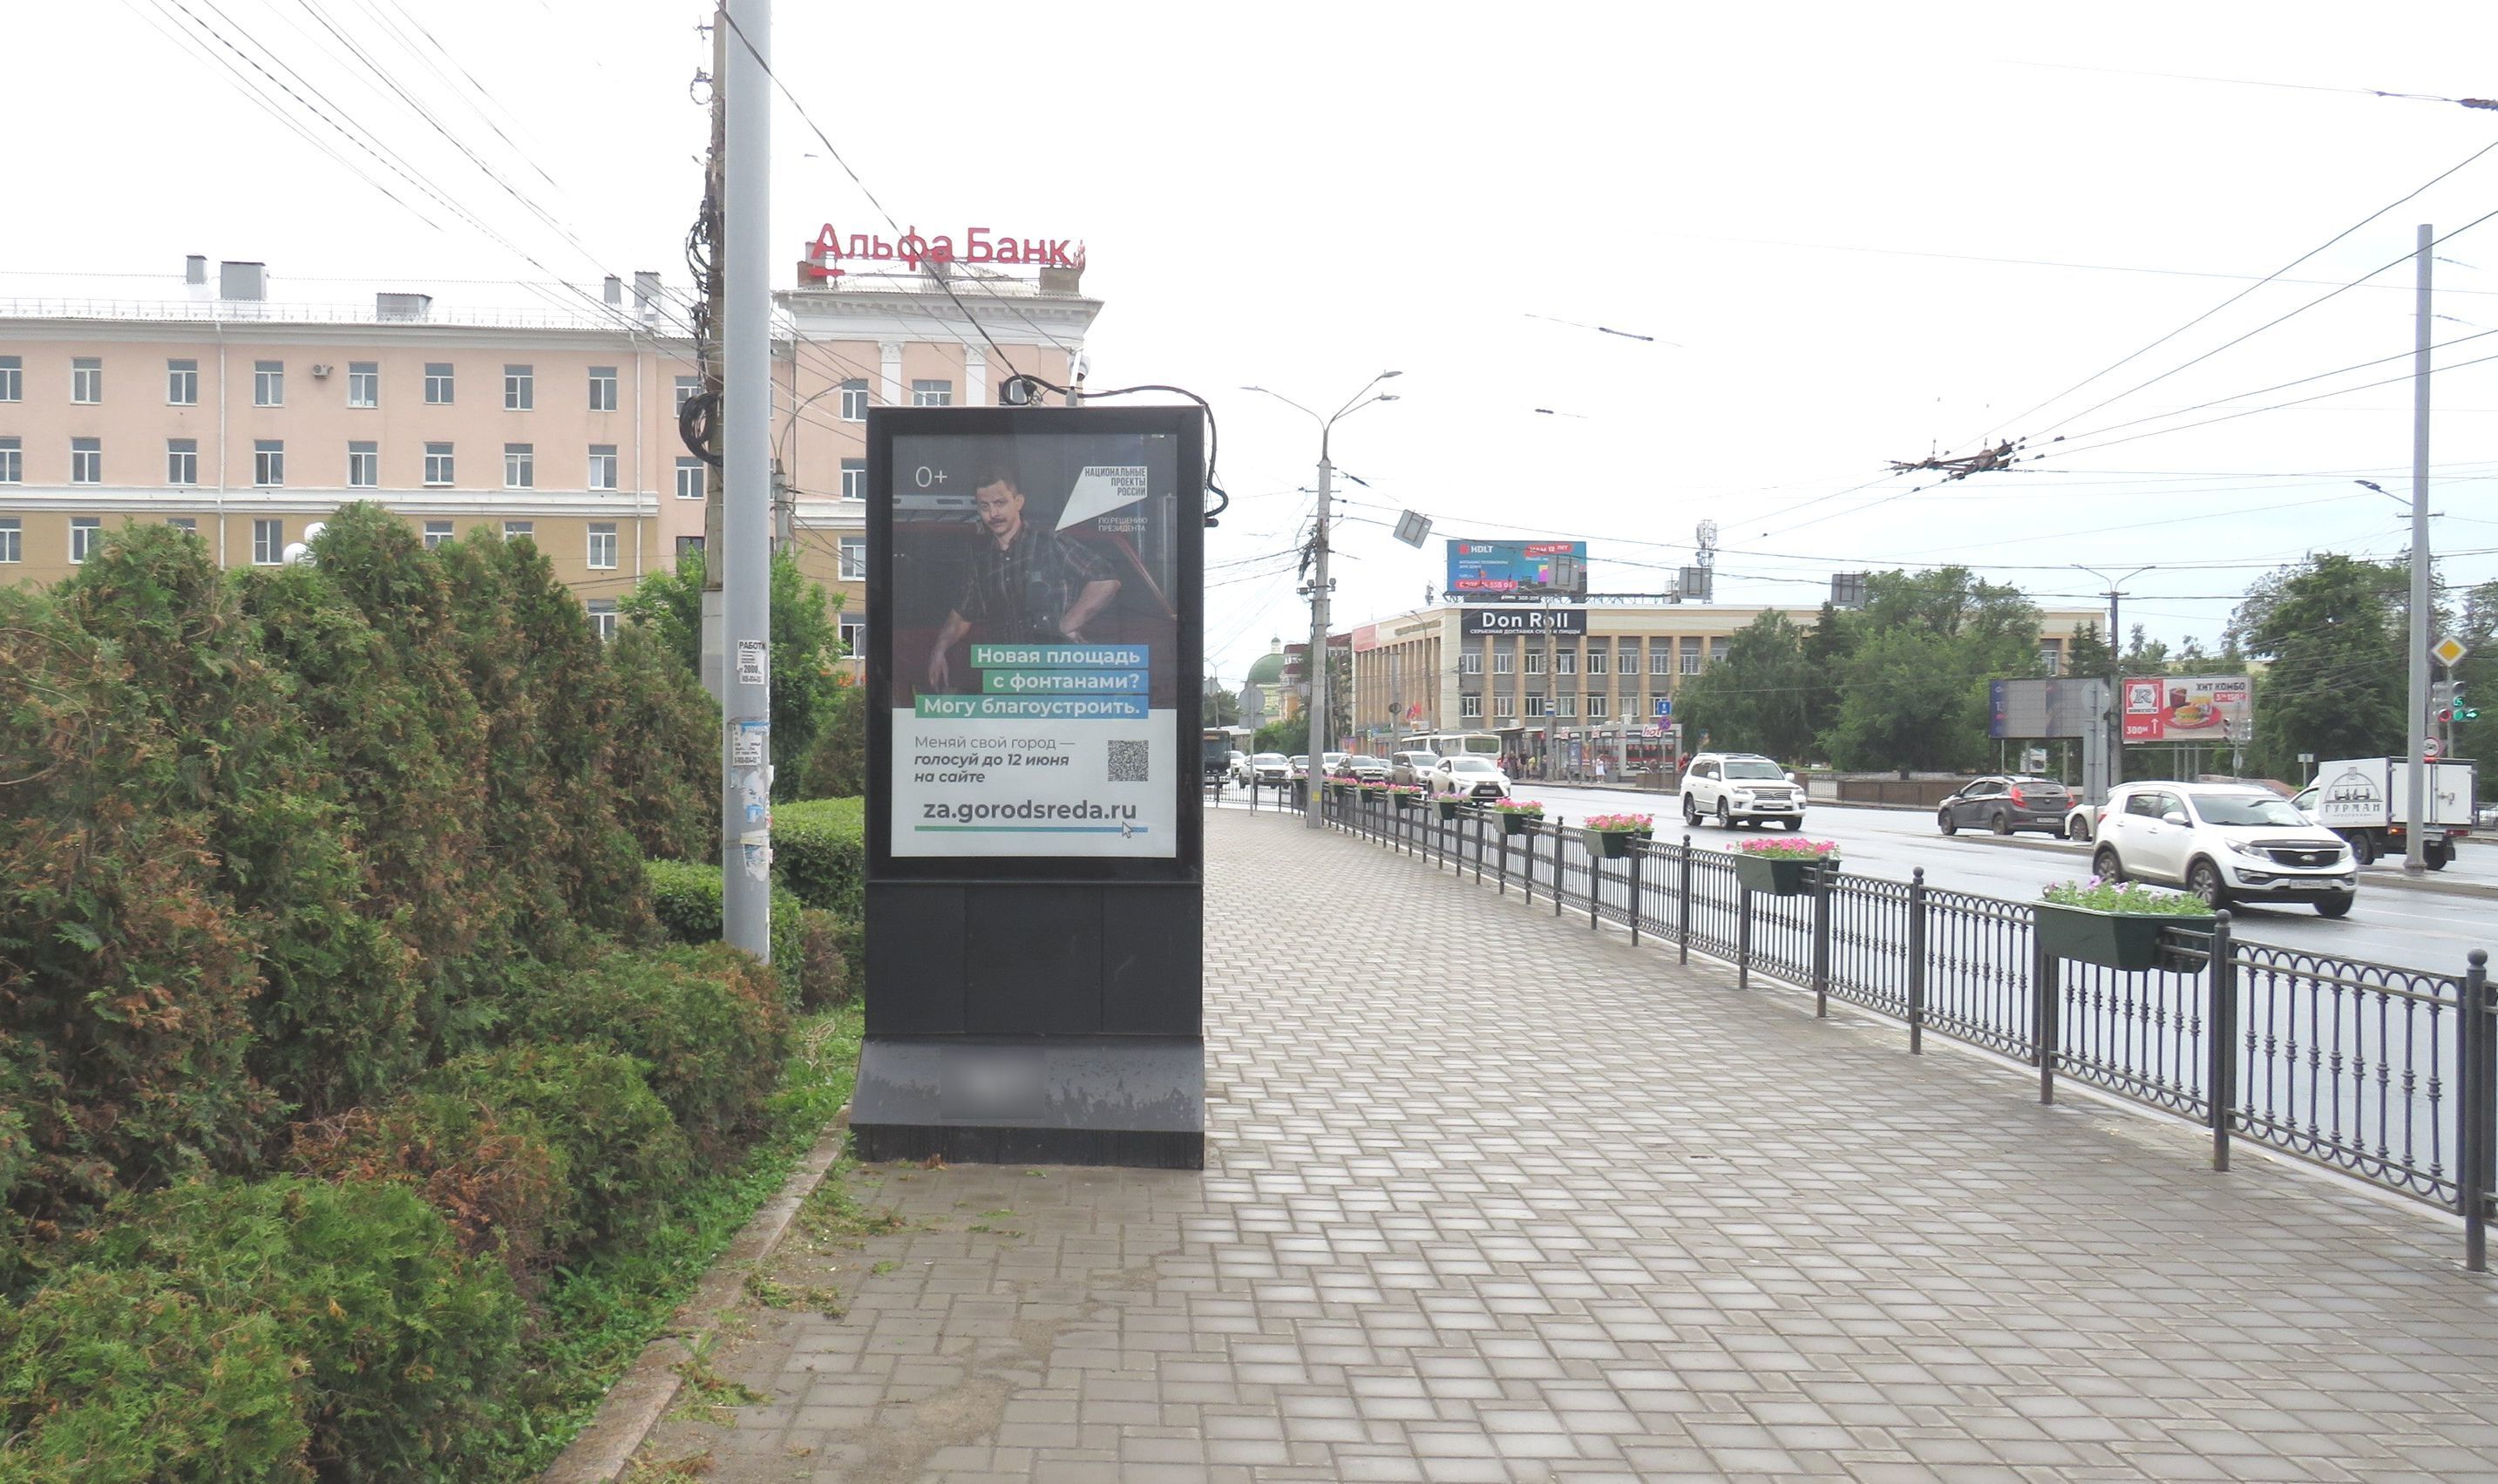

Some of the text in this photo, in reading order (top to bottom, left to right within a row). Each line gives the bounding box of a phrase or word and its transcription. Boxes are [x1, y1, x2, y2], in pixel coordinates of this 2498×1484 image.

[811, 223, 1076, 271] Альфа Банк
[915, 466, 947, 487] 0+
[1084, 467, 1146, 478] НАЦИОНАЛЬНЫЕ
[1110, 478, 1146, 486] ПРОЕКТЫ
[1117, 487, 1146, 496] РОССИИ
[1483, 613, 1568, 628] Don Roll
[739, 640, 766, 650] РАБОТА
[978, 647, 1140, 666] Новая площадь
[993, 673, 1139, 692] с фонтанами?
[924, 698, 1140, 717] Могу благоустроить.
[915, 735, 967, 749] Меняй
[971, 735, 1007, 749] свой
[1011, 741, 1056, 751] город
[914, 754, 1069, 769] голосуй до 12 июня
[914, 770, 986, 783] на сайте
[923, 800, 1137, 823] za.gorodsreda.ru
[2325, 803, 2380, 813] ГУРМАН
